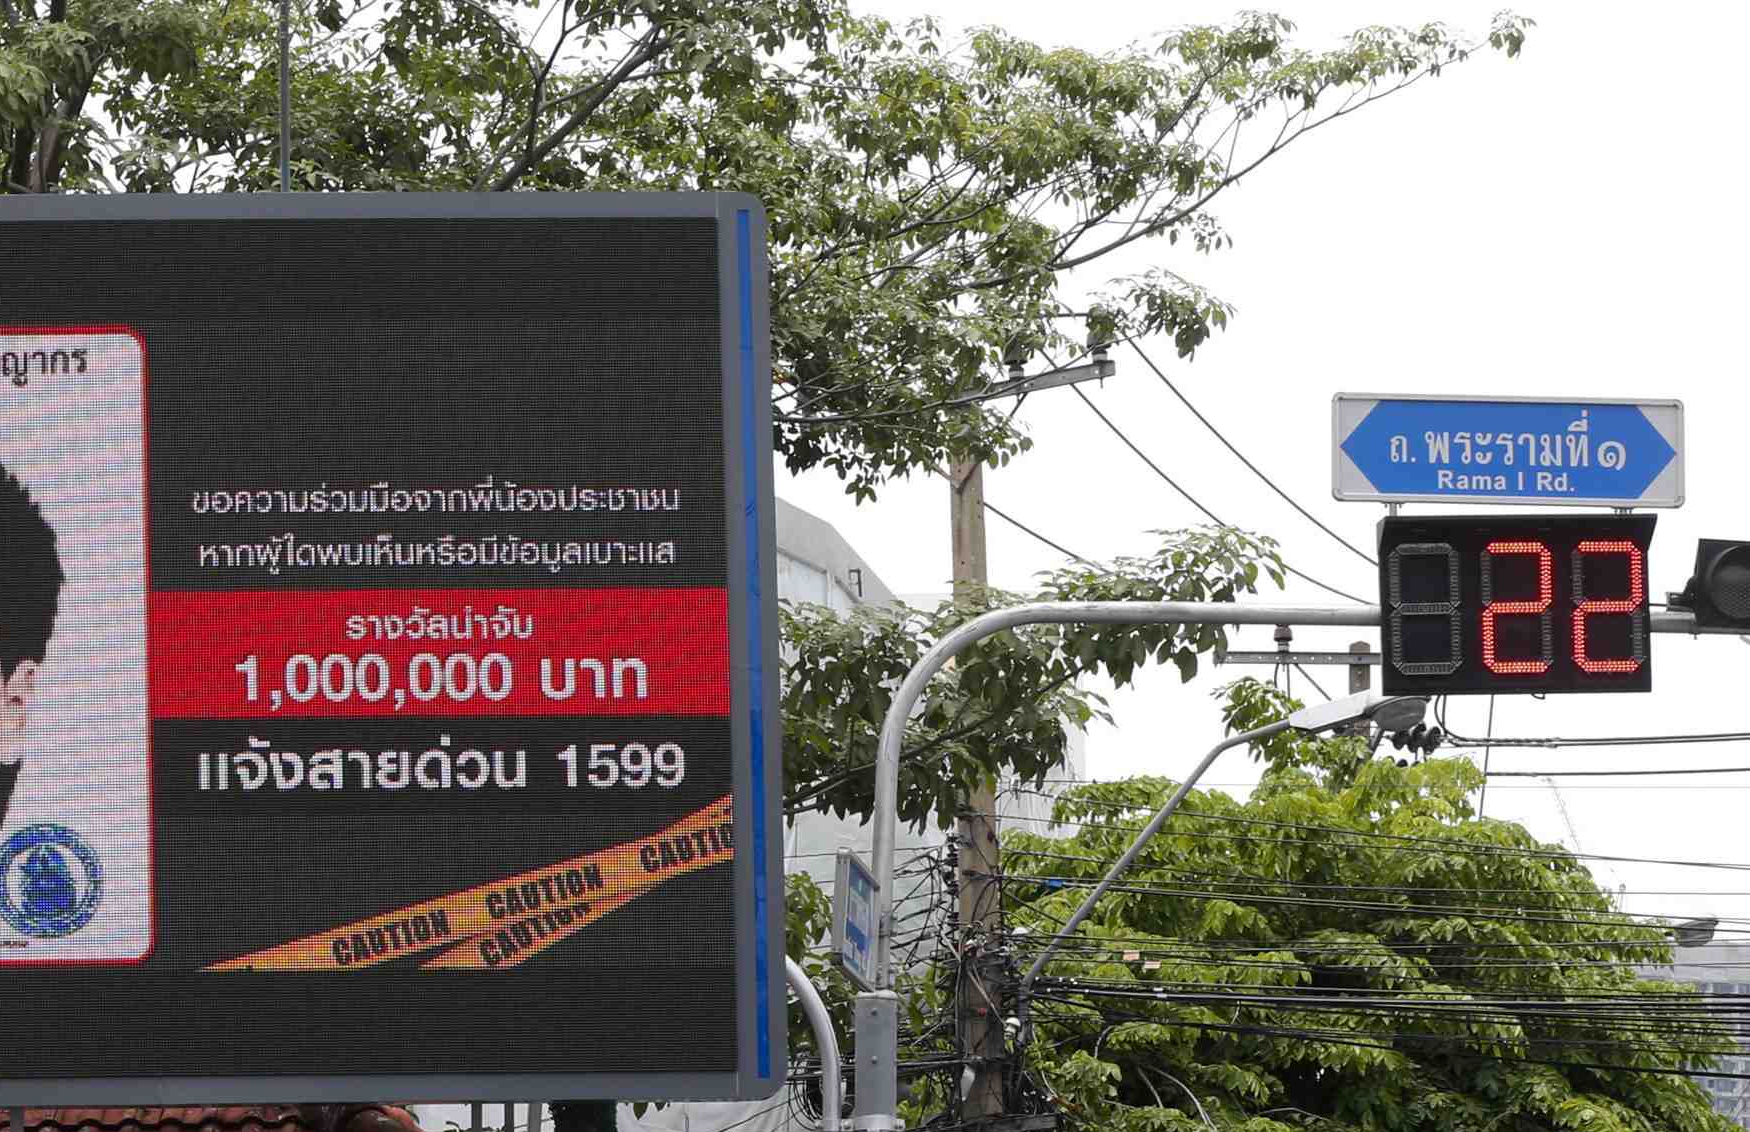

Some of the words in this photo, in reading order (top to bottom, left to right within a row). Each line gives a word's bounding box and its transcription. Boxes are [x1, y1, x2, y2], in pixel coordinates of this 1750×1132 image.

[1437, 470, 1506, 490] Rama
[1536, 472, 1575, 492] Rd.
[345, 606, 535, 640] รางวัลนำจับ
[1480, 540, 1644, 674] 22
[235, 652, 514, 711] 1,000,000
[539, 656, 649, 700] บาท
[196, 735, 527, 790] แจ้งสายด่วน
[556, 743, 687, 788] 1599
[485, 864, 604, 920] CAUTION
[331, 909, 450, 966] CAUTION
